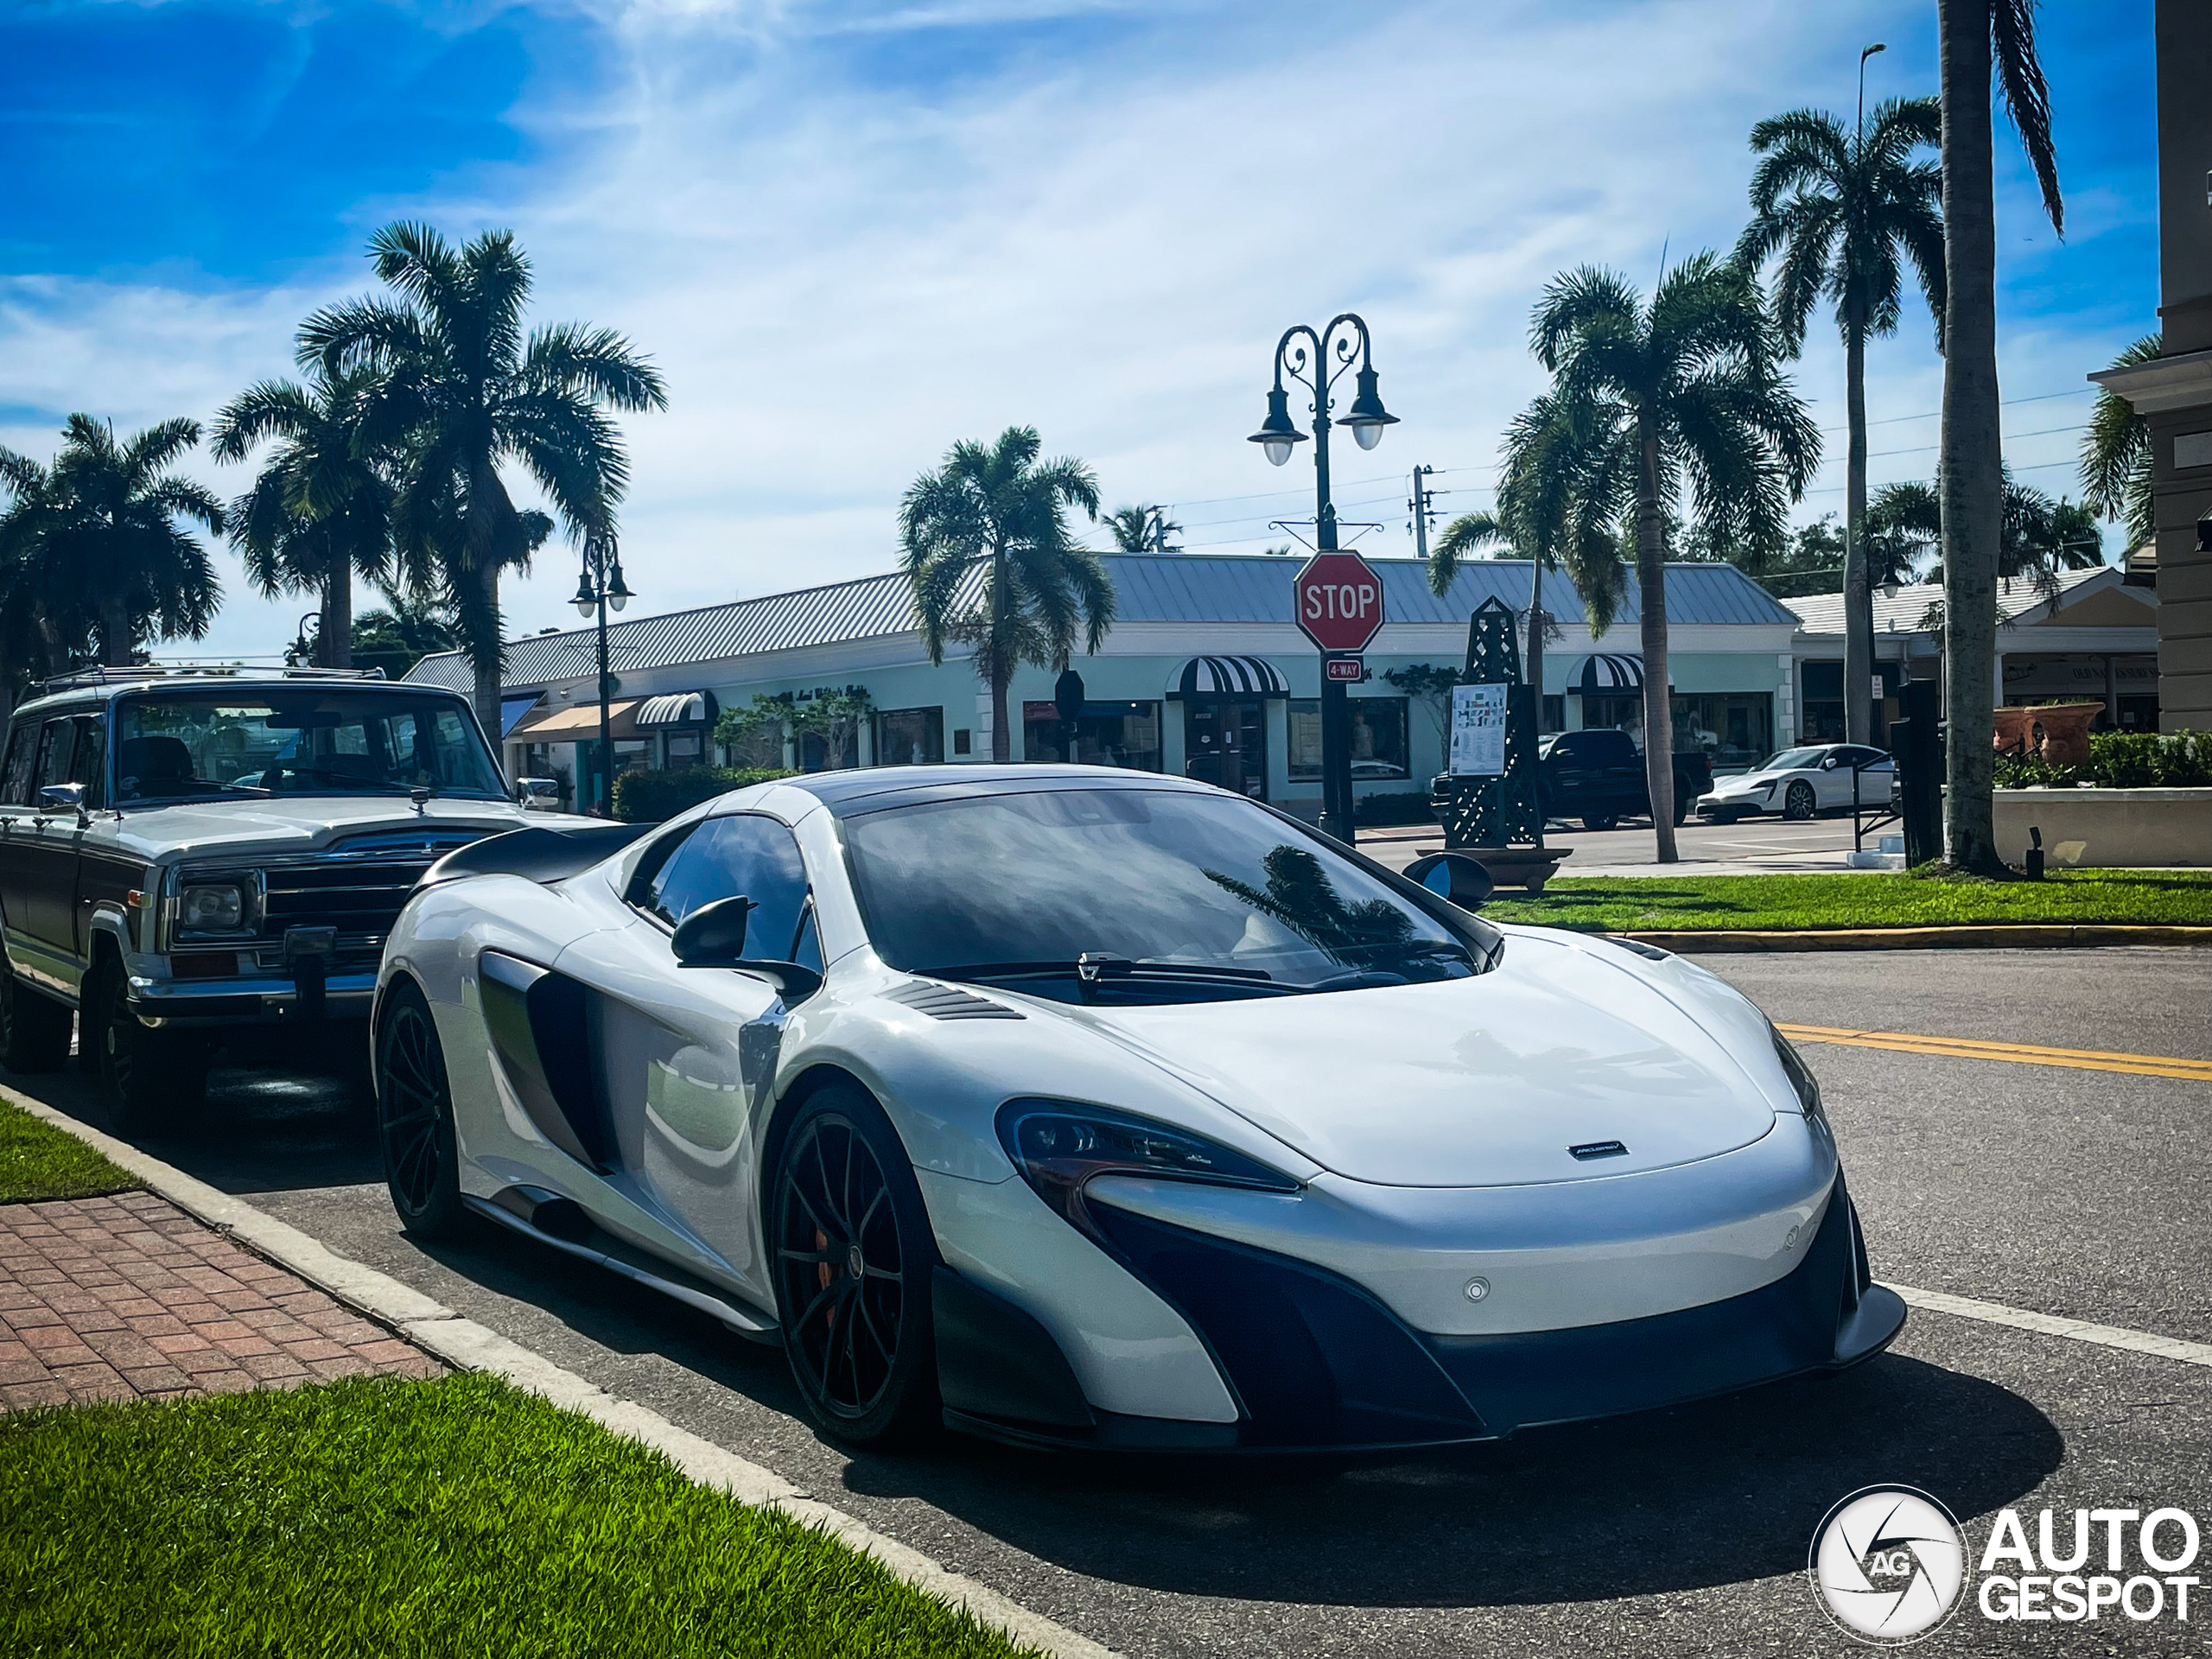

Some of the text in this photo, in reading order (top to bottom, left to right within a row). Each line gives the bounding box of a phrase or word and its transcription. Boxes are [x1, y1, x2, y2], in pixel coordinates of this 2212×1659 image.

[1306, 585, 1374, 619] STOP
[1331, 664, 1357, 676] 4-WAY
[2073, 667, 2092, 679] OLD
[2093, 667, 2126, 679] NAES
